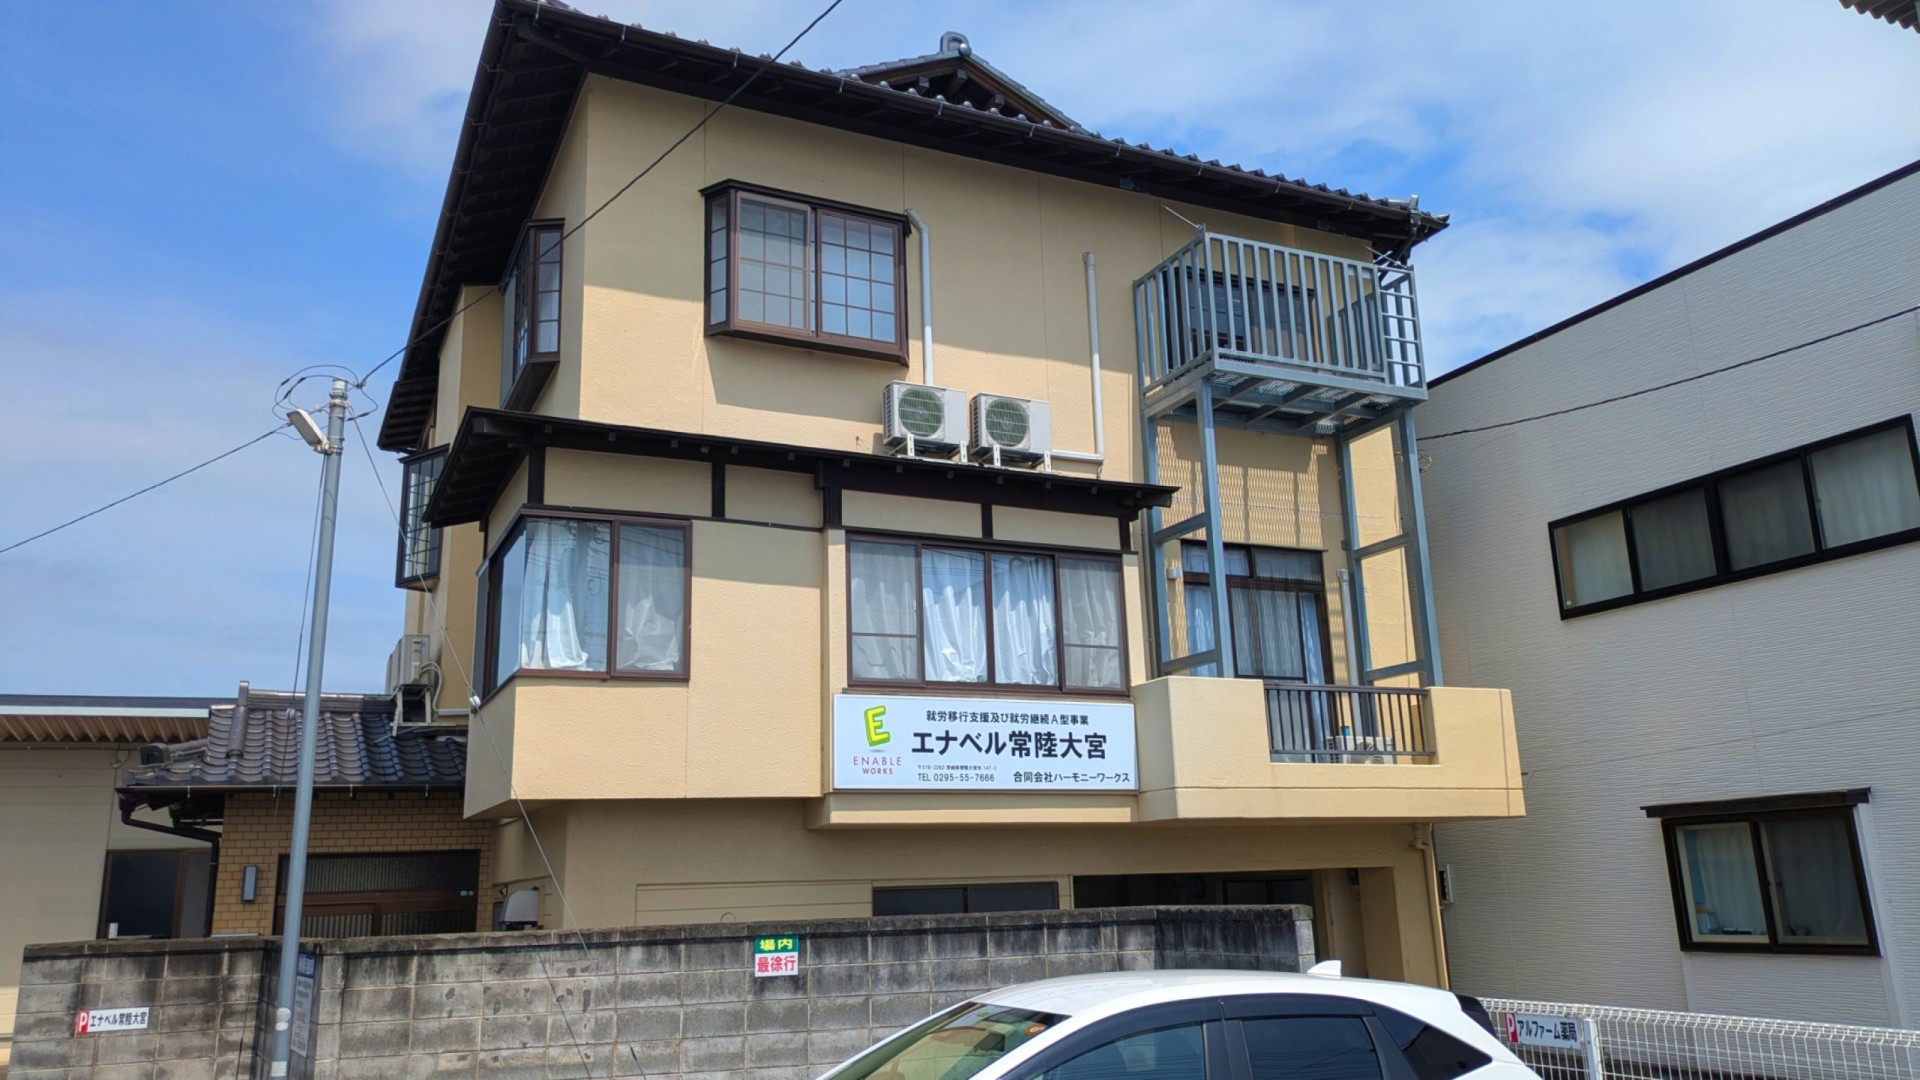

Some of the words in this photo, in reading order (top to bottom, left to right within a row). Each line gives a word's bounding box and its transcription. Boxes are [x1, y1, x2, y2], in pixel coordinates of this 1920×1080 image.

[911, 729, 1107, 760] エナベル常陸大宮
[853, 756, 902, 766] ENABLE
[862, 767, 894, 775] WORKS
[917, 773, 931, 782] TEL
[933, 773, 995, 782] 0295-55-7666
[1013, 771, 1130, 783] 合同会社ハーモニーワークス
[760, 938, 793, 951] 場内
[757, 955, 796, 973] 最徐行
[89, 1011, 148, 1027] エナベル常陸大宮
[1517, 1020, 1577, 1042] アルファーム薬局
